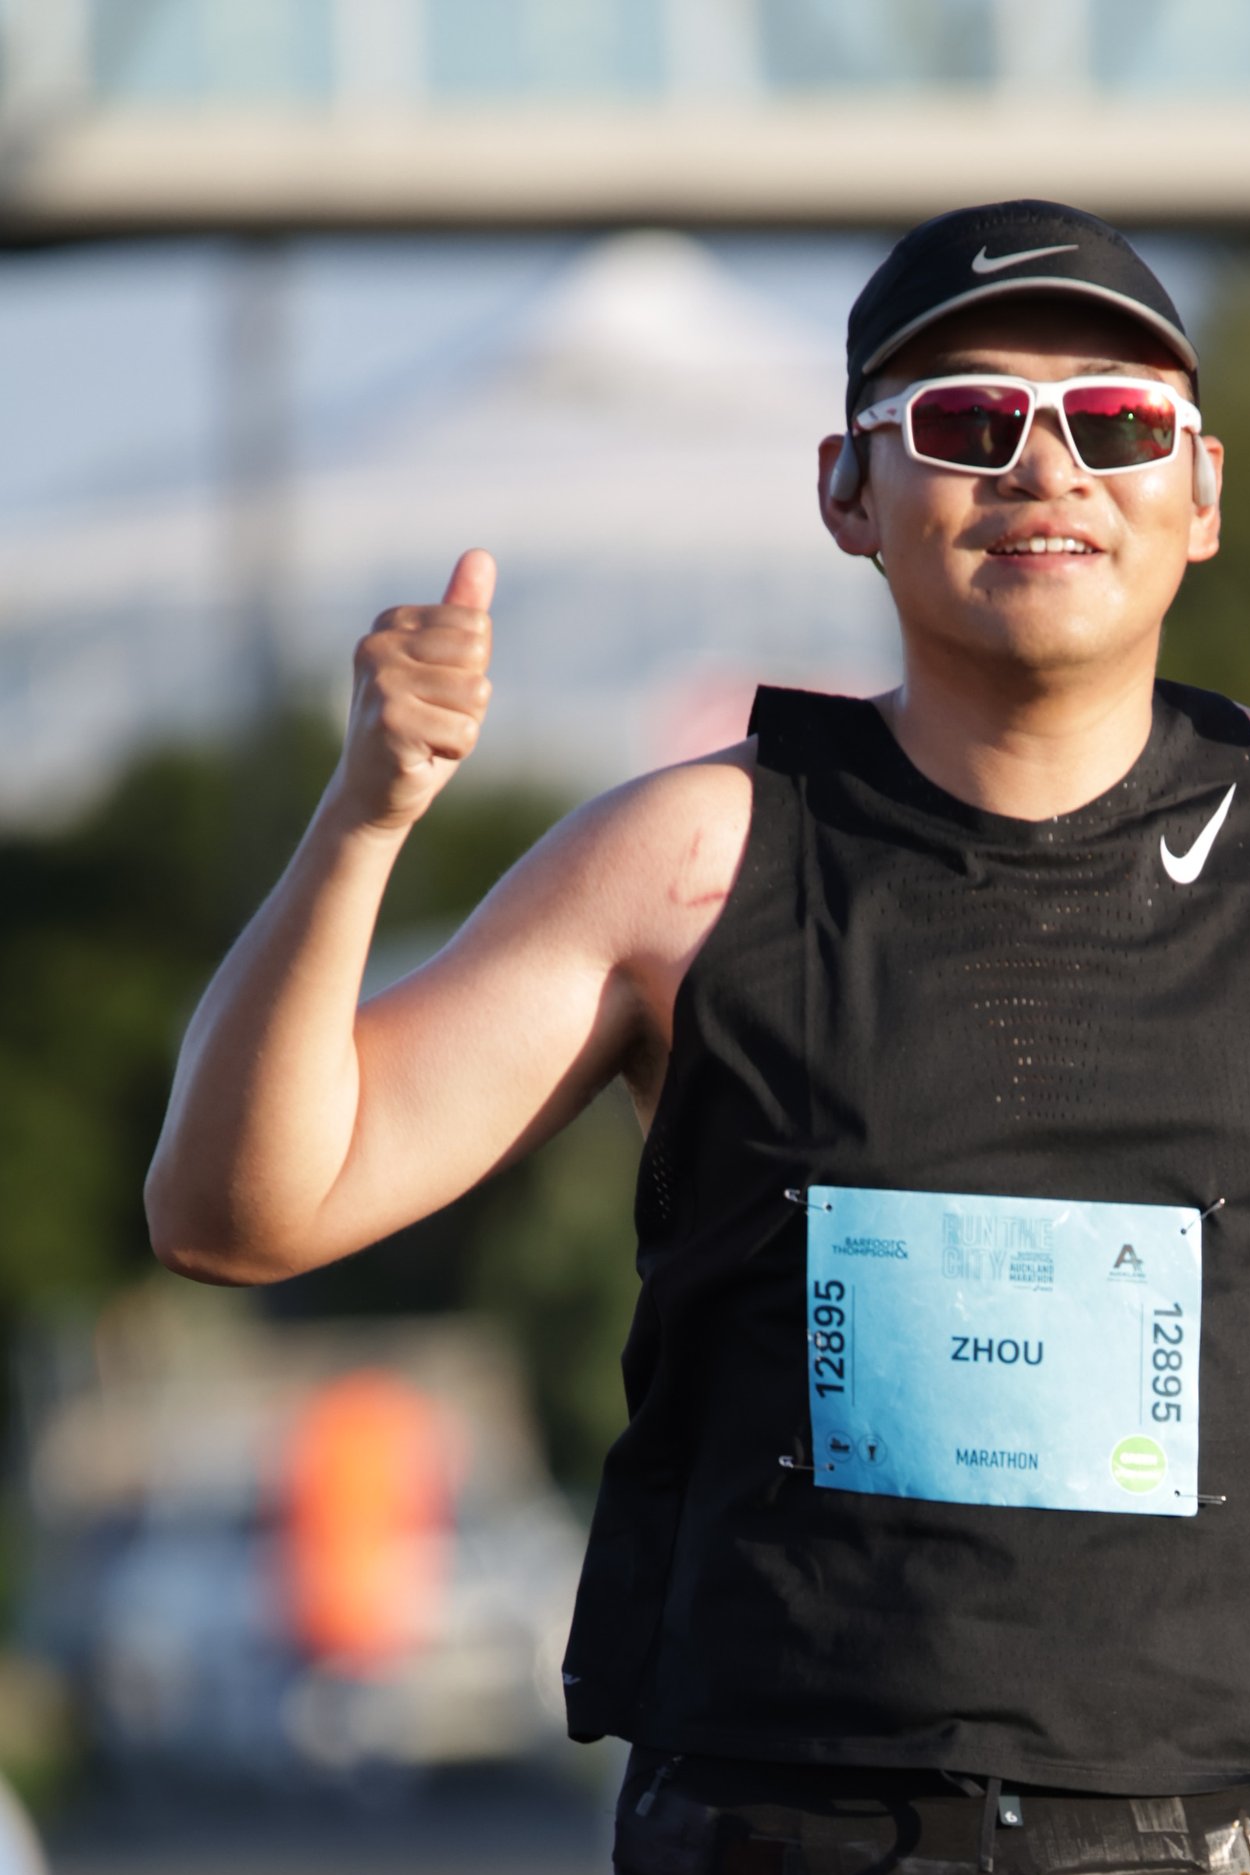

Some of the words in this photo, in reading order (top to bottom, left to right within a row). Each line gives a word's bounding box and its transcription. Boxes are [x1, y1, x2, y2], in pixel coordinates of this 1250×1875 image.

[942, 1213, 998, 1248] RUN
[1000, 1216, 1055, 1250] THE
[941, 1246, 1008, 1281] CITY
[814, 1280, 845, 1399] 12895
[951, 1336, 1044, 1366] ZHOU
[1152, 1302, 1184, 1423] 12895
[955, 1448, 1039, 1470] MARATHON
